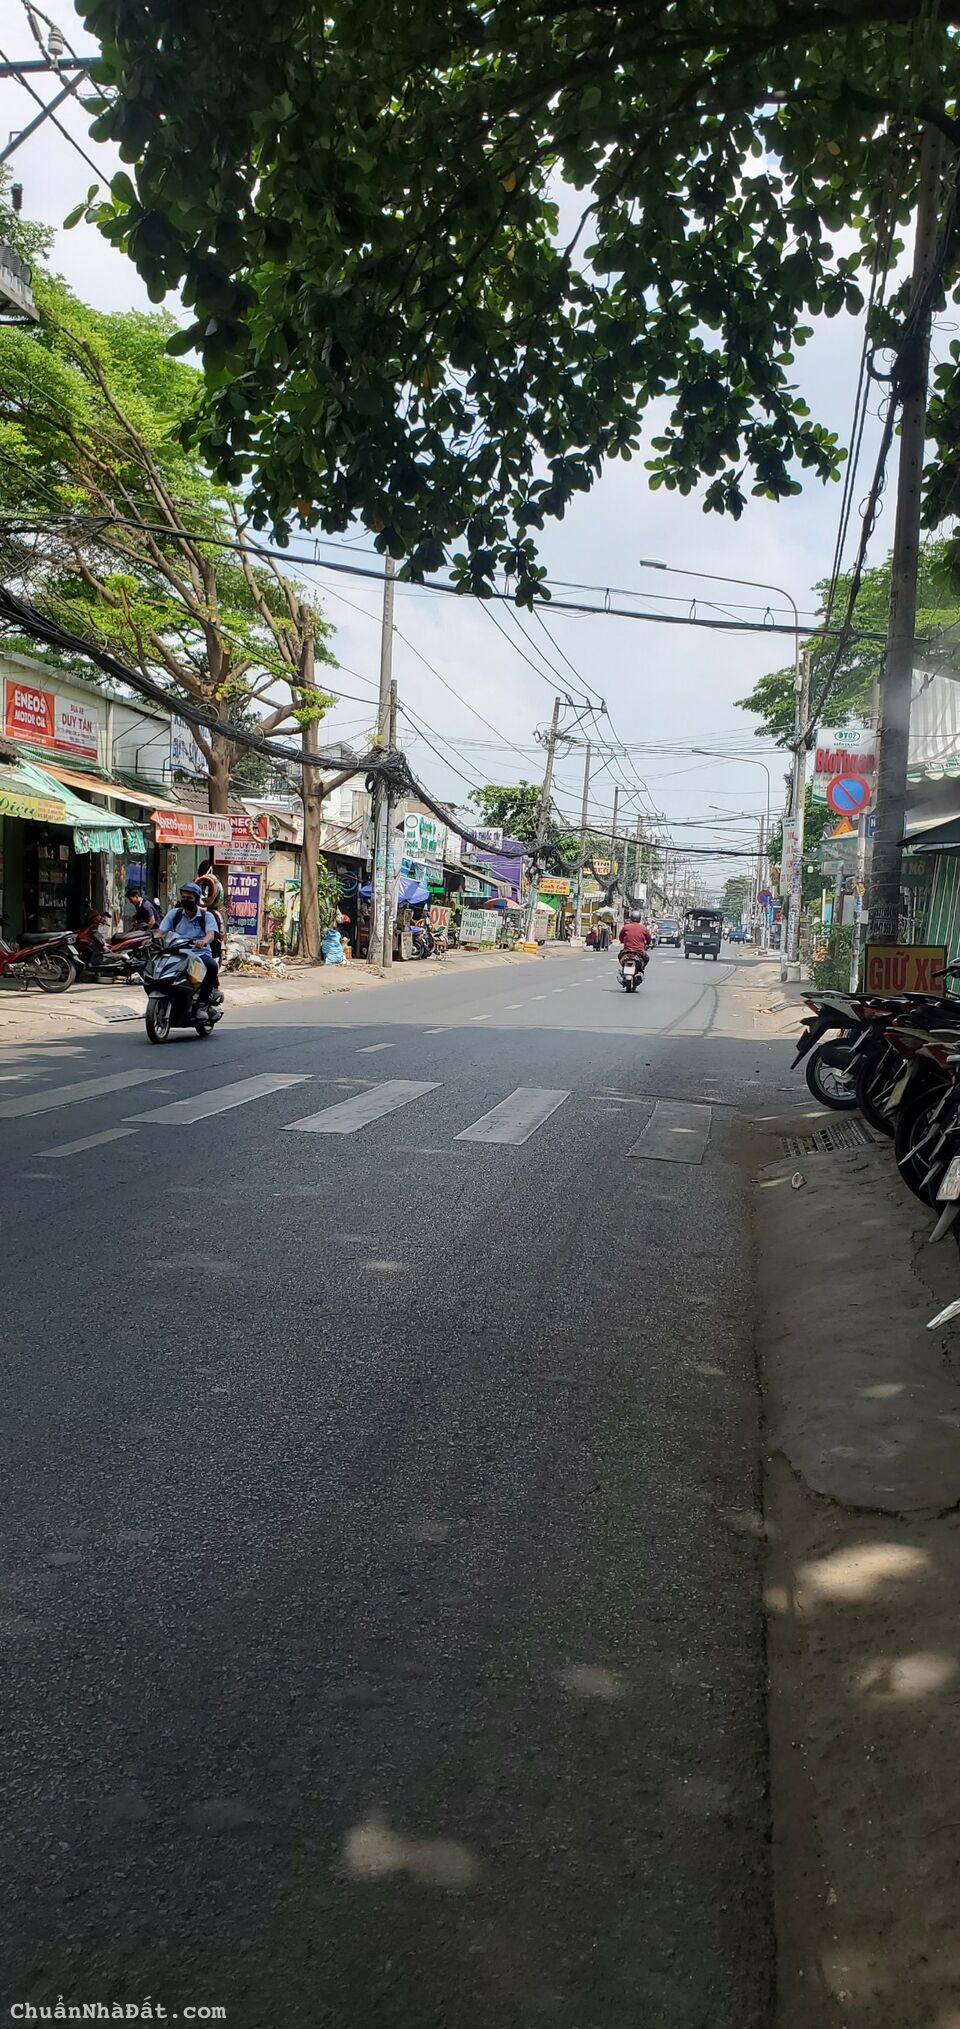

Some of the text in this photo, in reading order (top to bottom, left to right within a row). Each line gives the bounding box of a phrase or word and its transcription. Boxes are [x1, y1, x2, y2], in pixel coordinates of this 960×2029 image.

[14, 689, 46, 714] ENEOS
[14, 710, 46, 728] MOTOR OIL
[62, 713, 77, 728] DUY
[160, 817, 178, 830] ENEOS
[228, 816, 259, 828] NEOS
[228, 886, 250, 897] NAM
[431, 907, 448, 926] OK
[869, 951, 944, 992] GIỮ XE
